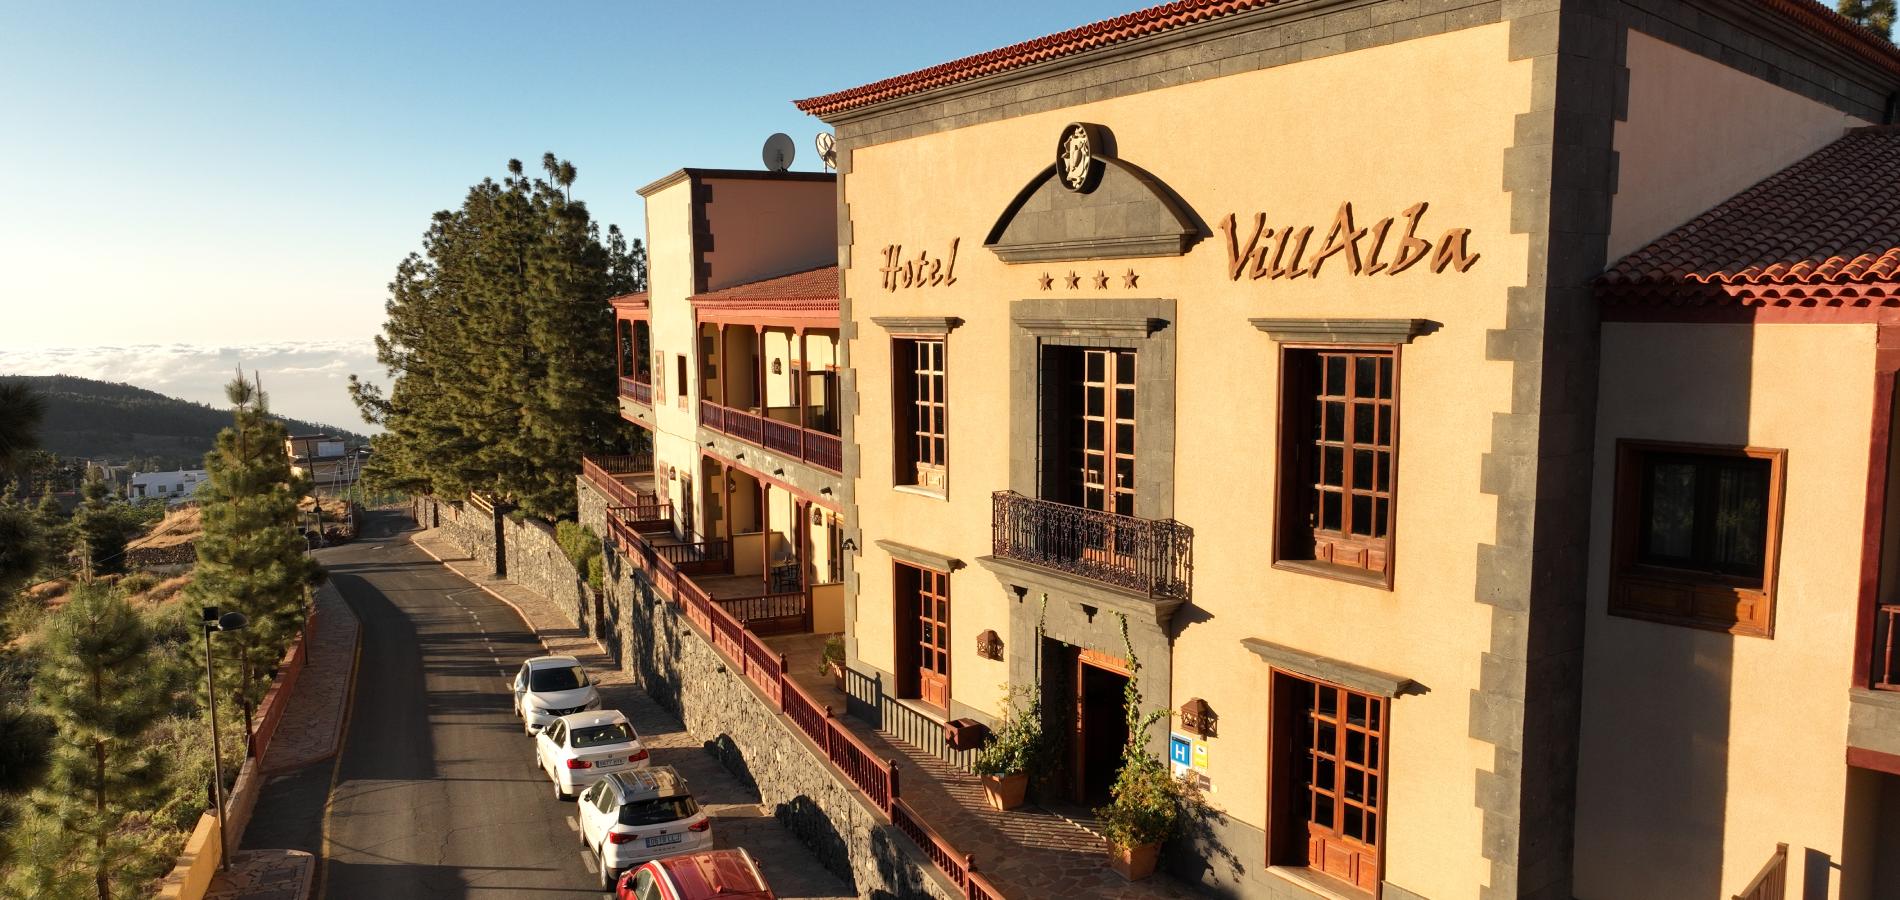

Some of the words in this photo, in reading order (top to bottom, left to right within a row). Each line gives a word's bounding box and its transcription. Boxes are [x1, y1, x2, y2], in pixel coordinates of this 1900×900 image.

[880, 236, 960, 293] Hotel
[1218, 201, 1480, 281] VillAlba
[1175, 744, 1185, 761] H
